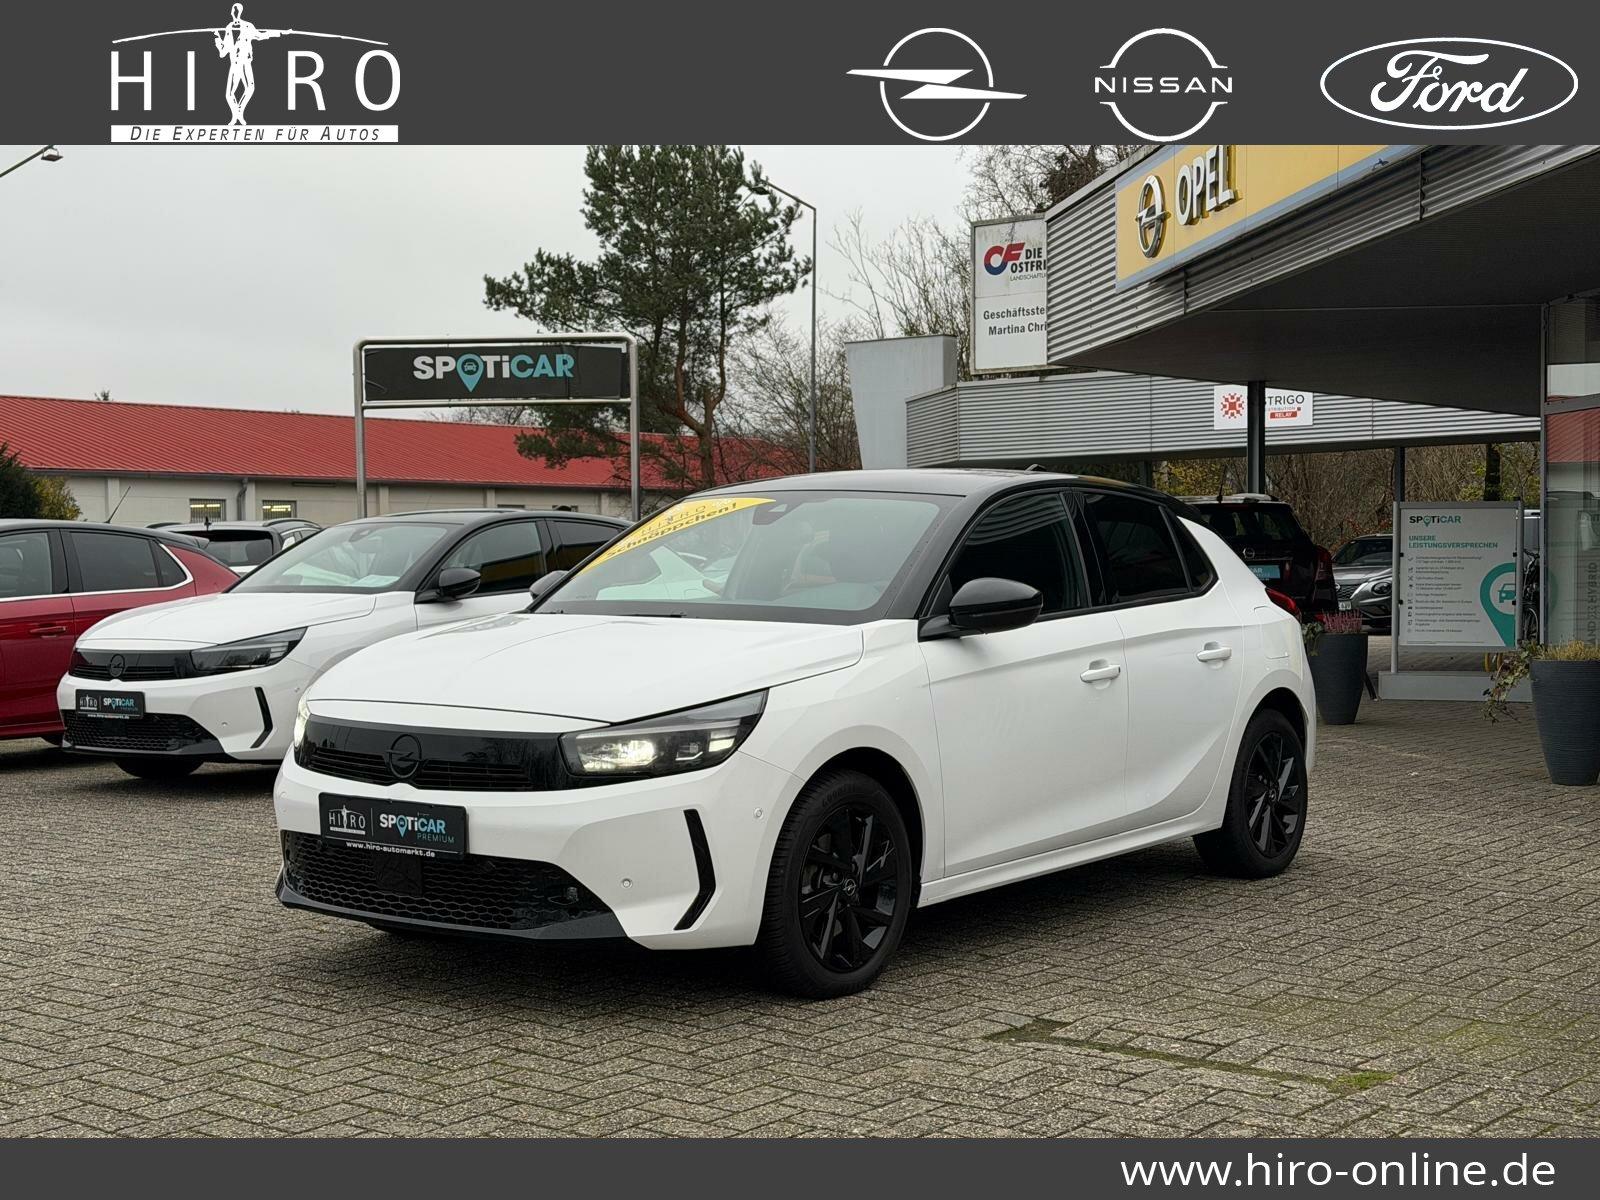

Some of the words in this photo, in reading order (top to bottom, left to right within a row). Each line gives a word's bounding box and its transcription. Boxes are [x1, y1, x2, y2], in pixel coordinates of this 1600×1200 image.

[1175, 145, 1234, 225] OPEL
[1025, 247, 1043, 260] DIE
[983, 306, 1045, 320] Geschäftsste
[988, 324, 1026, 336] Martina
[1266, 394, 1305, 406] TRIGO
[328, 812, 366, 829] HIRO
[417, 832, 455, 844] PREMIUM
[346, 841, 436, 858] www.hiro-automarkt.de
